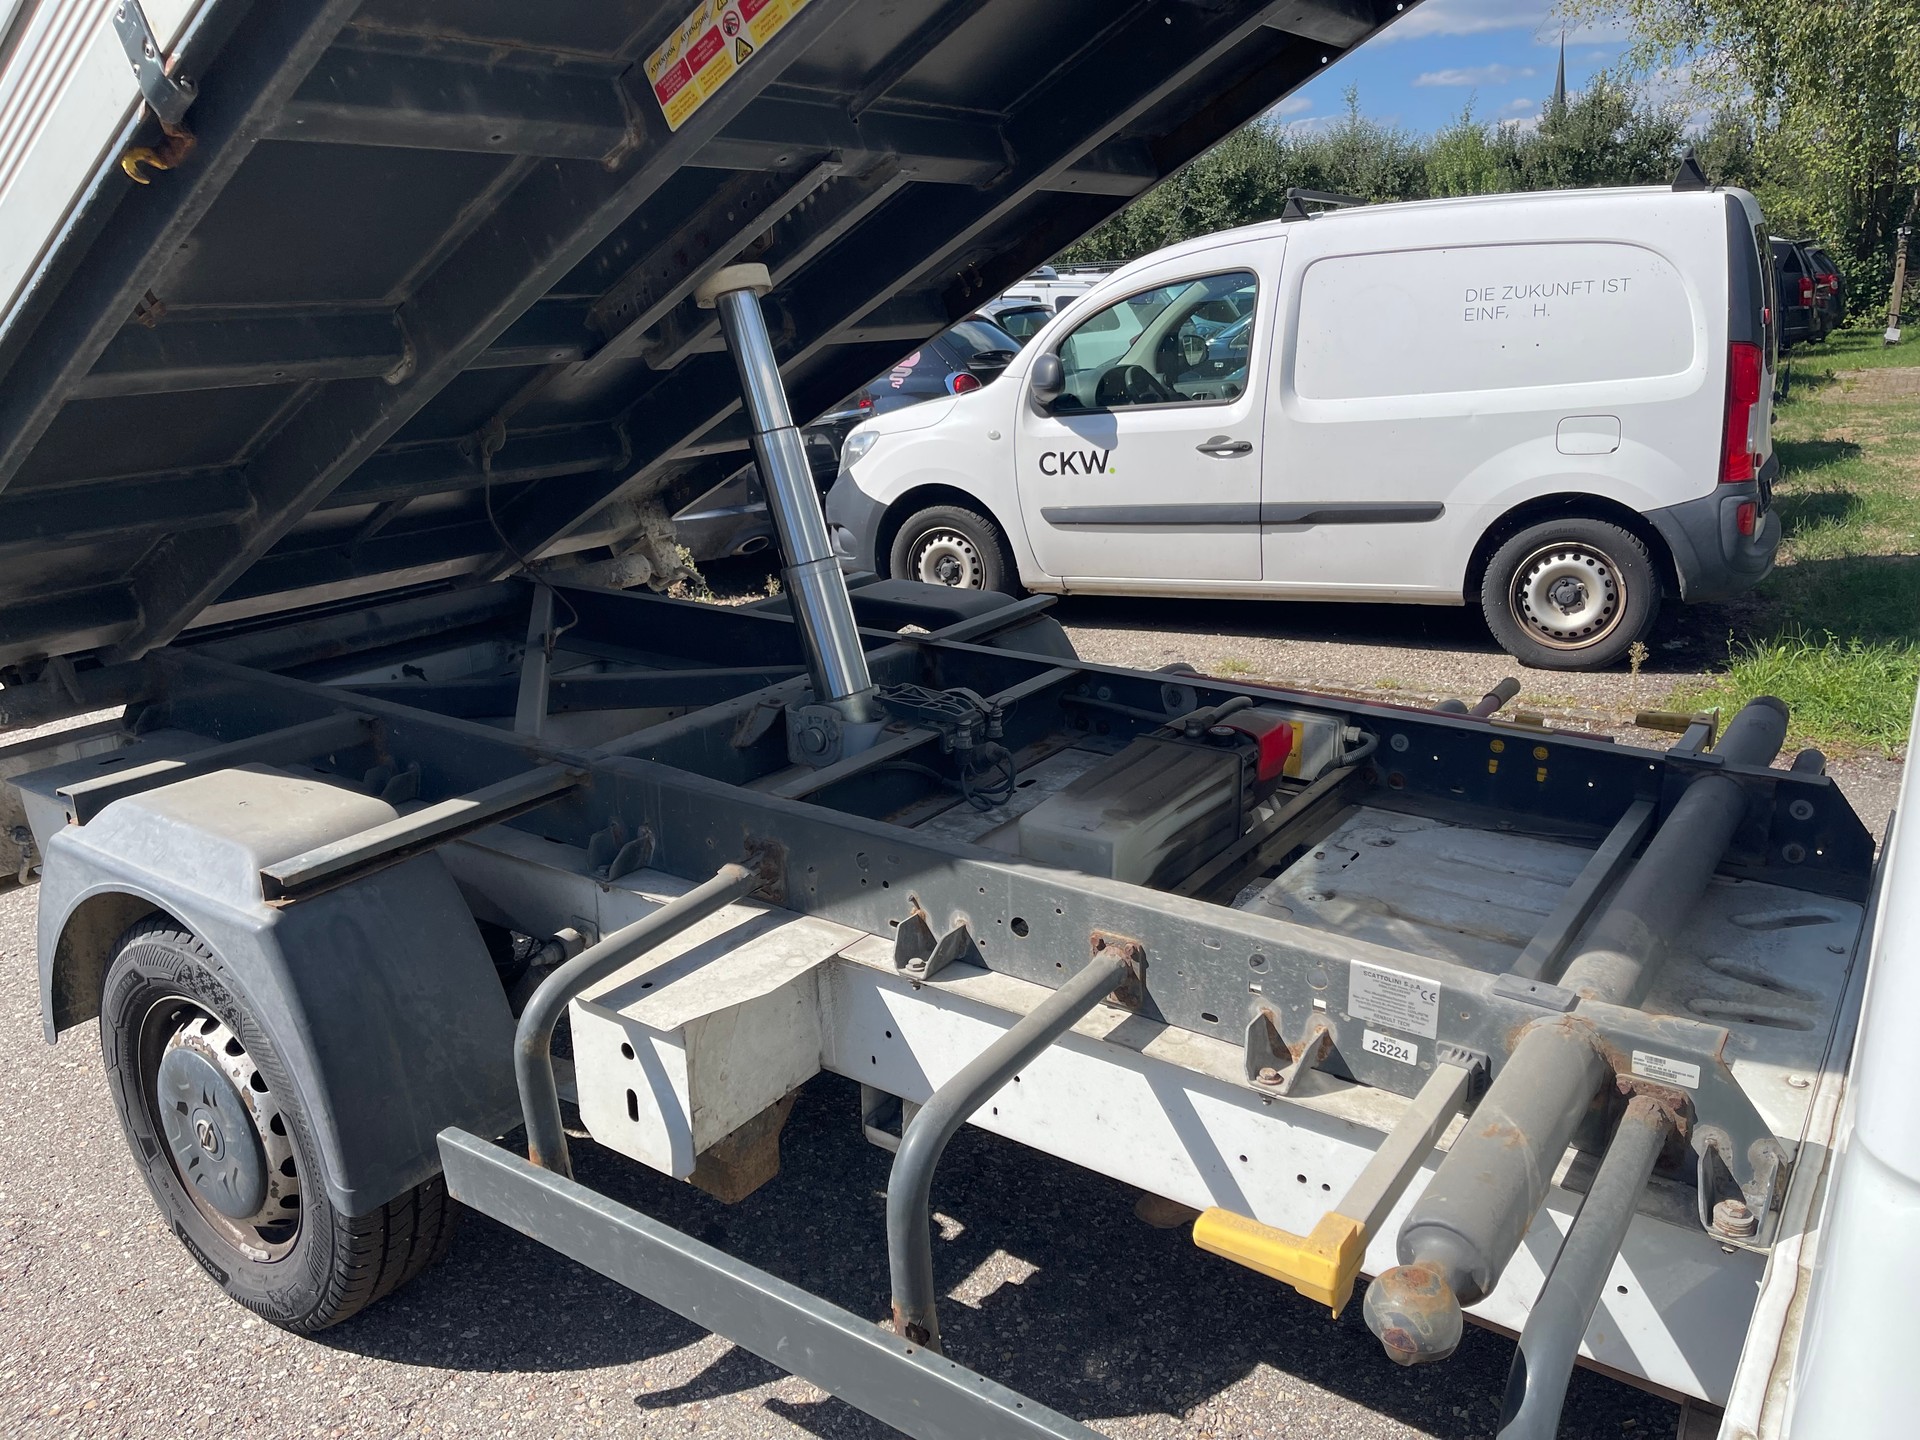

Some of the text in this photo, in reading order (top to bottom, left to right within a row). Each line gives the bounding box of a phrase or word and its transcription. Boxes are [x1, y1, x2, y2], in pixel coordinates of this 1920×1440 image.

[650, 45, 676, 73] ATTENTION
[680, 11, 710, 43] ATTENZIONE
[1465, 277, 1632, 302] DIE ZUKUNFT IST
[1363, 970, 1402, 986] SCATTOLINI
[1372, 1039, 1409, 1061] 25224
[186, 1240, 223, 1281] SNOVANIS
